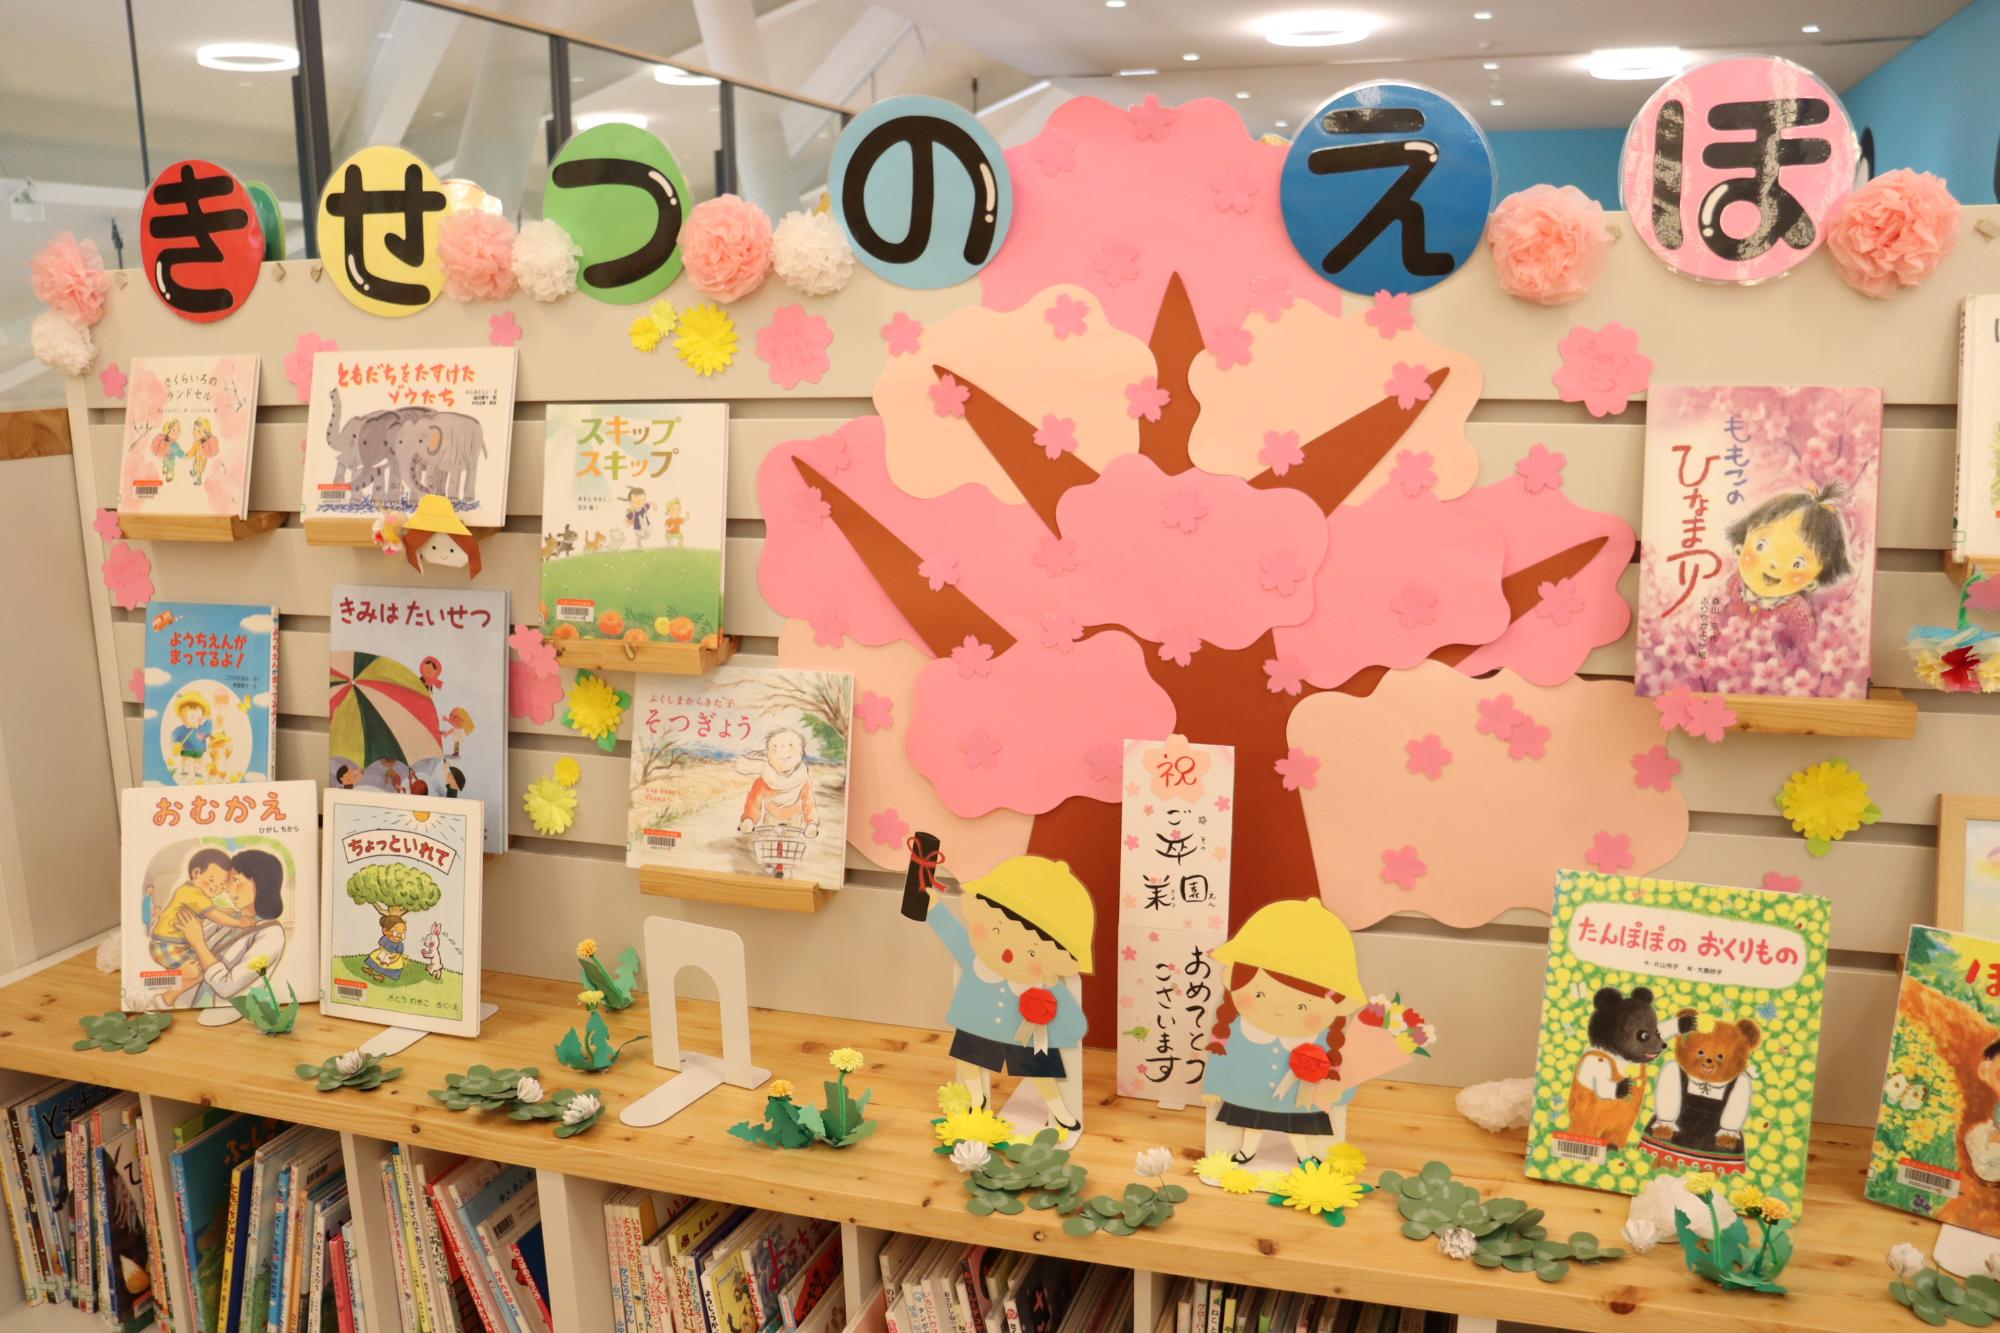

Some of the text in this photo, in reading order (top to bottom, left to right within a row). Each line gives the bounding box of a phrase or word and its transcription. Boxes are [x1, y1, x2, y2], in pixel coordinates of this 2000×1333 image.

[149, 97, 1832, 313] き せ つ の え ほ
[163, 373, 219, 389] さくらいろの
[337, 361, 477, 388] ともだちをたすけた
[165, 388, 213, 402] ランドセル
[387, 387, 456, 408] ゾウたち
[577, 415, 682, 446] スキップ
[575, 447, 680, 480] スキップ
[1723, 415, 1751, 505] ももこの
[1661, 444, 1722, 619] ひなまつり
[338, 597, 492, 629] きみは たいせつ
[169, 631, 249, 651] ようちえんが
[645, 708, 752, 741] そつぎょう
[1156, 753, 1198, 788] 祝
[152, 790, 287, 827] おむかえ
[347, 834, 451, 866] ちょっといれて
[1577, 915, 1799, 967] たんぽぽの おくりもの
